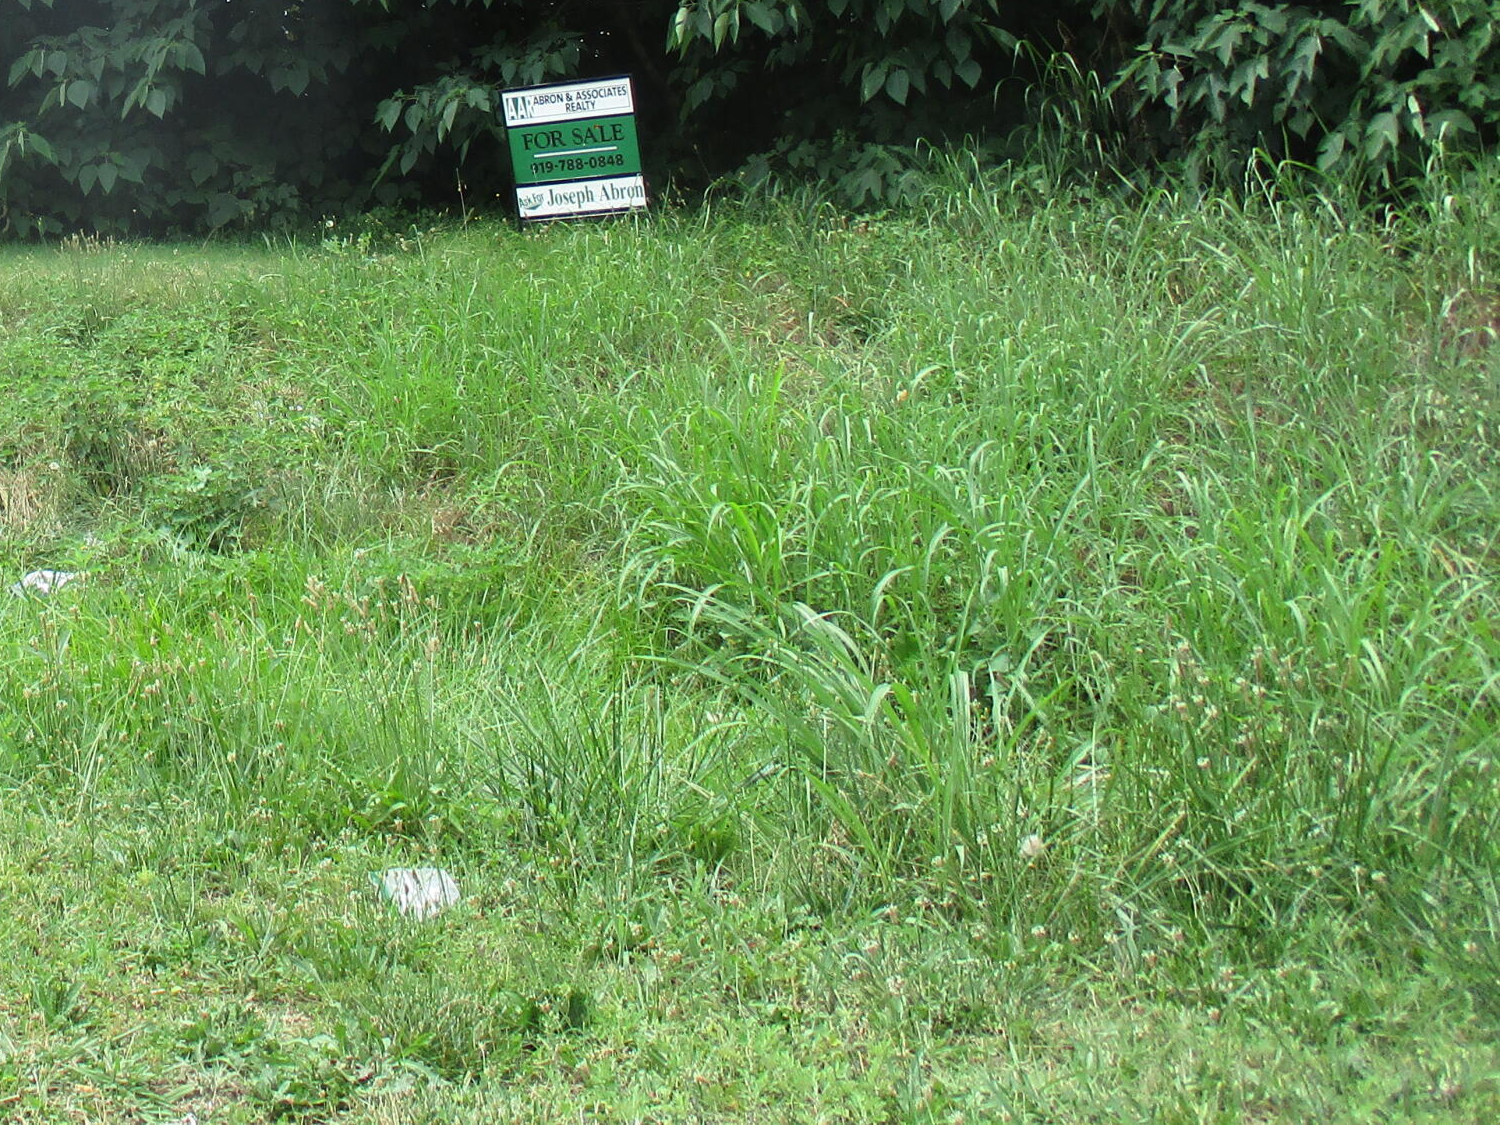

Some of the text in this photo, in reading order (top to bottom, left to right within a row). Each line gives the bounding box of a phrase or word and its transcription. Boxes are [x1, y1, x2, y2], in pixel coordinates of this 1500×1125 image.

[533, 86, 627, 106] ABRON & ASSOCIATES
[565, 100, 596, 112] REALTY
[522, 123, 625, 151] FOR SALE
[531, 154, 624, 176] 919-788-0848
[519, 196, 533, 208] Ask
[547, 185, 595, 209] Joseph
[599, 182, 644, 202] Abron
